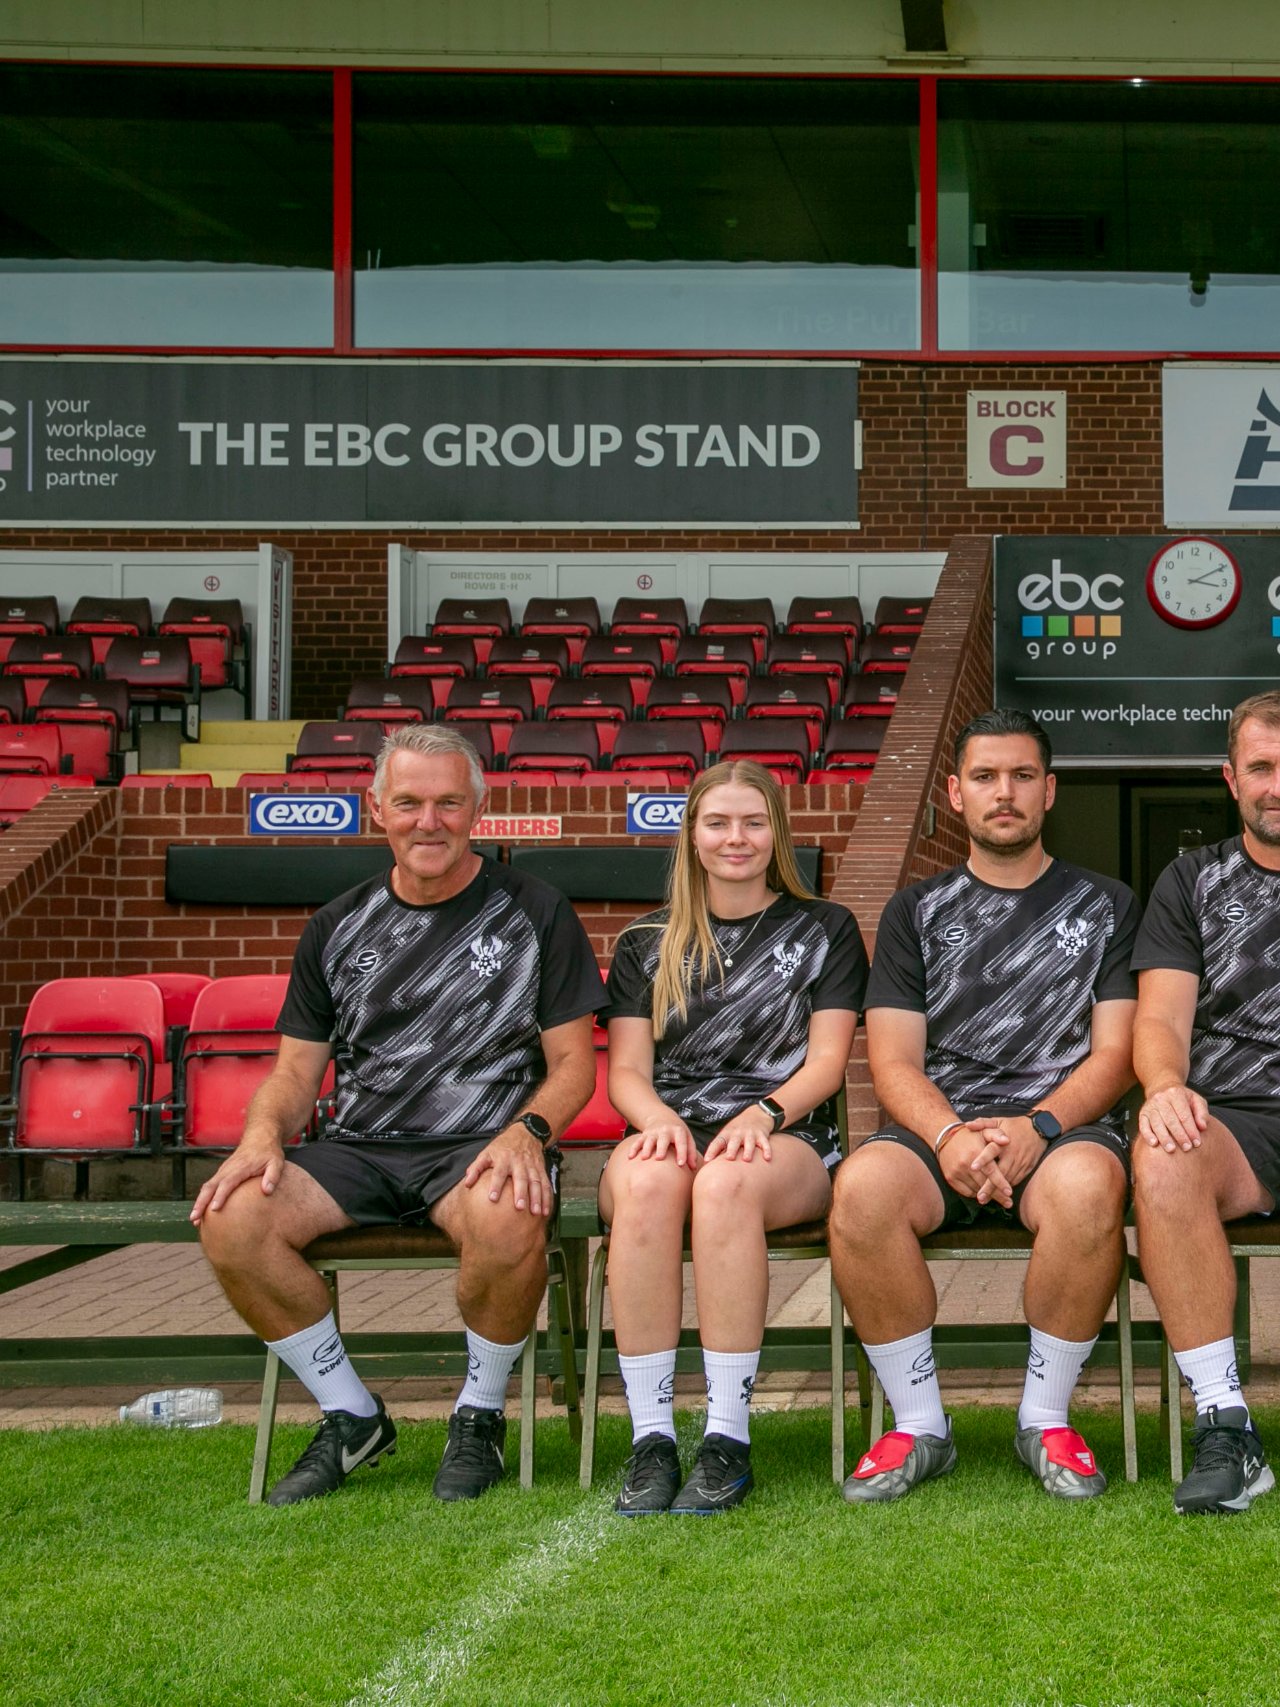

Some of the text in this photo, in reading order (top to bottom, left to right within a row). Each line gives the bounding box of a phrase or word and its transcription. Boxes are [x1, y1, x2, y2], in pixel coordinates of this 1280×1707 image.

[45, 399, 91, 417] your
[976, 400, 1056, 418] BLOCK
[45, 419, 147, 442] workplace
[178, 422, 821, 468] THE EBC GROUP STAND
[989, 424, 1044, 476] C
[45, 444, 157, 467] technology
[45, 470, 119, 490] partner
[1191, 547, 1200, 556] 12
[1165, 561, 1175, 570] 10
[450, 571, 533, 581] DIRECTORS BOX
[1018, 559, 1124, 611] ebc
[1026, 641, 1117, 660] group
[1032, 707, 1075, 723] your
[1081, 704, 1177, 726] workplace
[1183, 704, 1233, 721] techn
